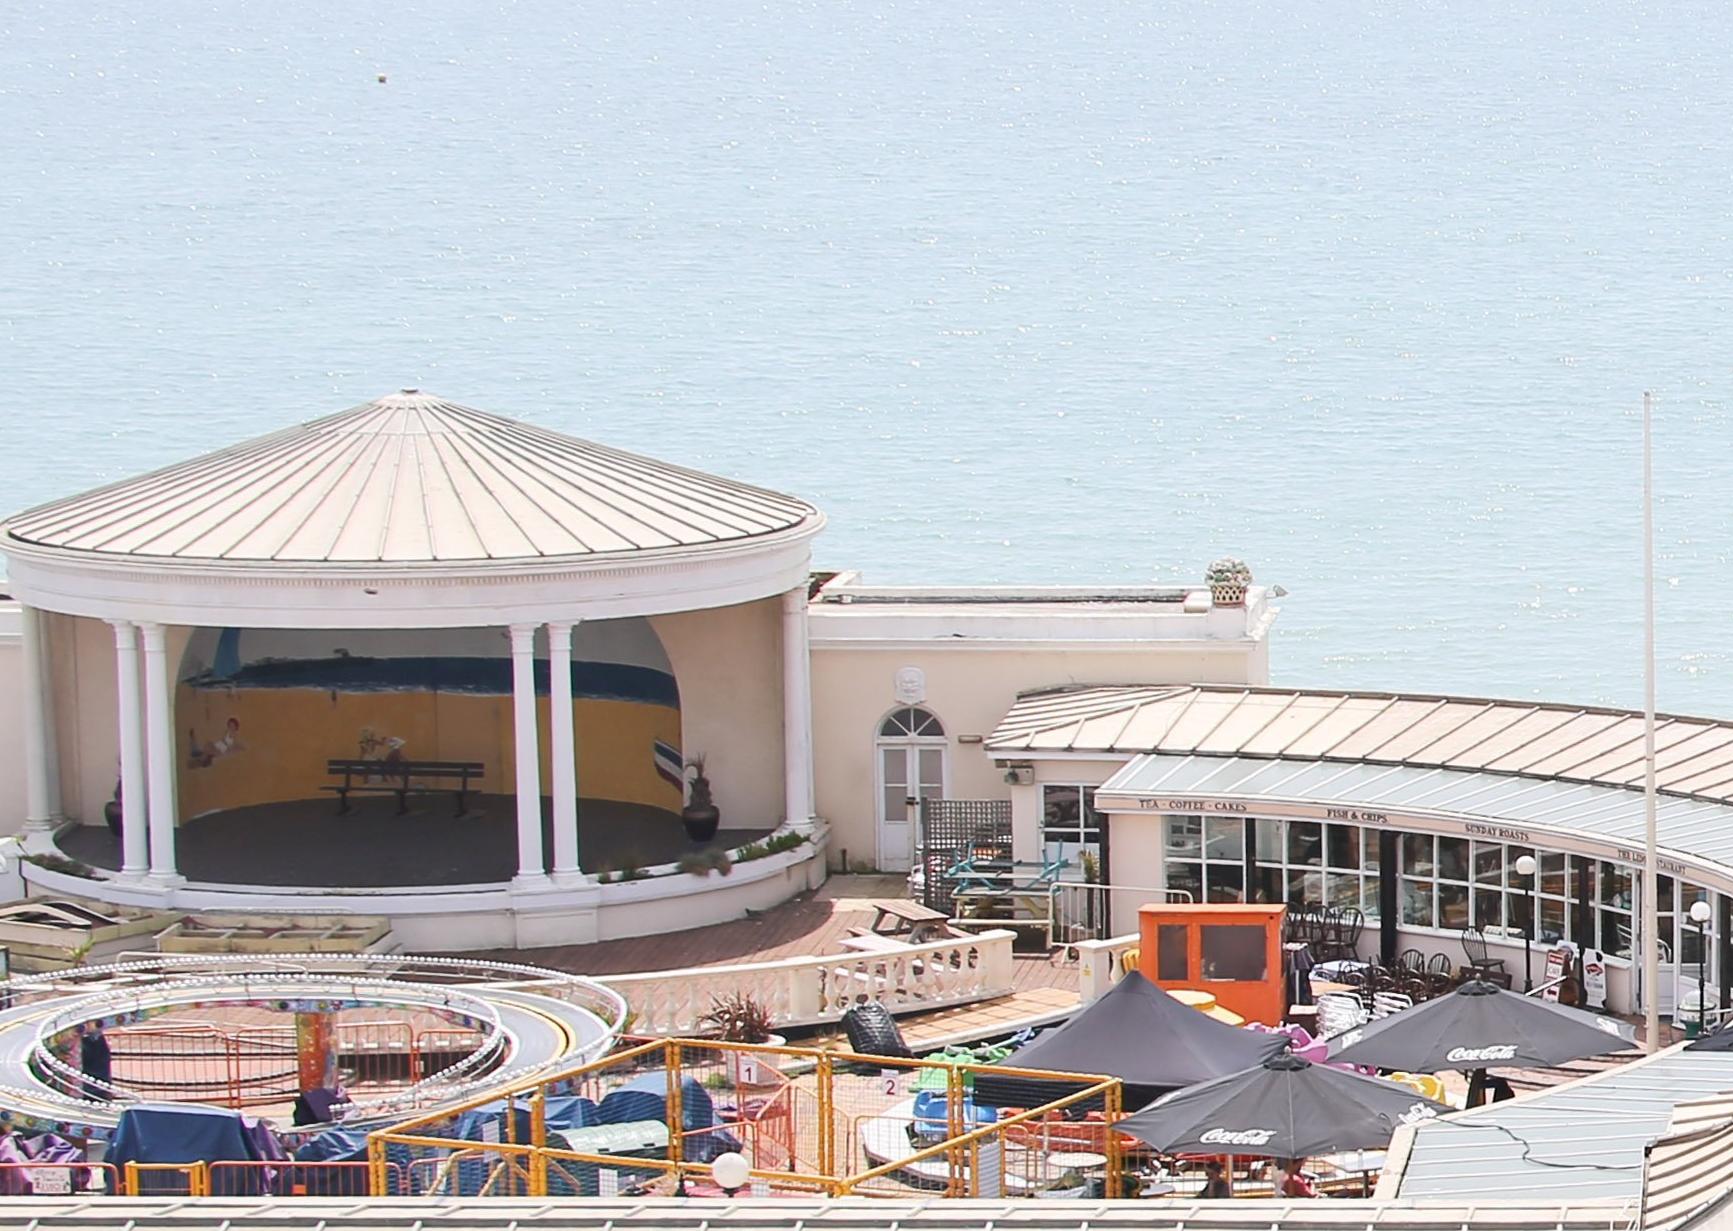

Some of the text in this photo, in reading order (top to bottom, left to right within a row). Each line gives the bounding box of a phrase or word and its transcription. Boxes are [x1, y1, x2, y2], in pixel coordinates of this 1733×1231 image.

[1139, 799, 1248, 812] TEA COFFEE CAKES
[1327, 808, 1388, 824] FISH & CHIPS
[1465, 823, 1530, 842] SUNDAY ROASTS
[1446, 1045, 1519, 1062] Coca-Cola
[744, 1066, 753, 1082] 1
[885, 1079, 897, 1096] 2
[1199, 1128, 1277, 1146] Coca-Cola
